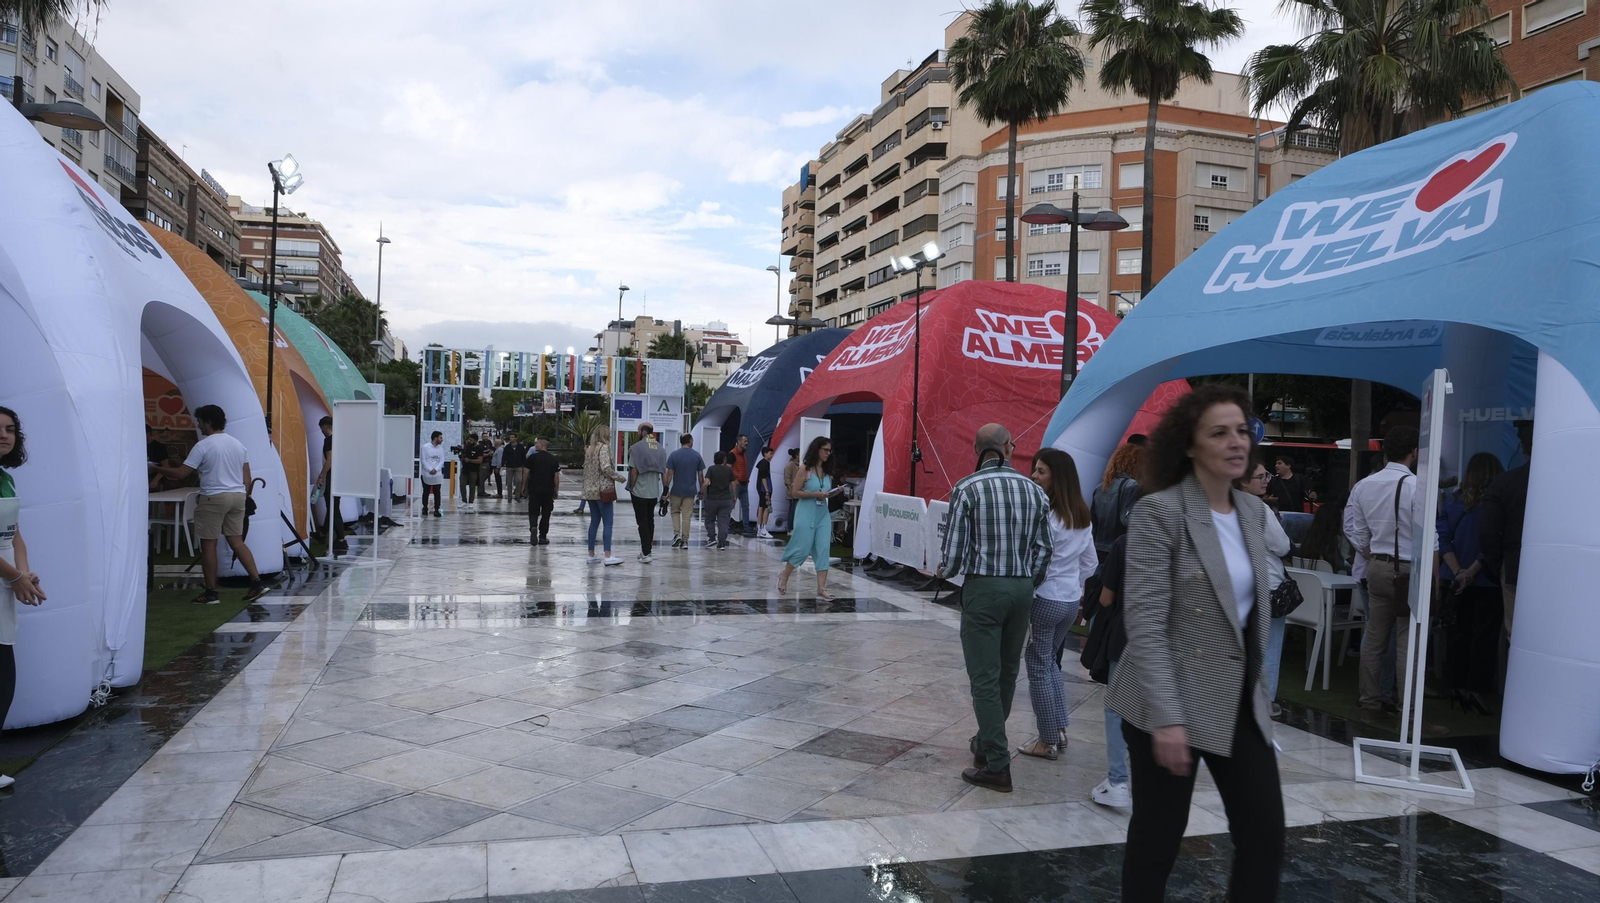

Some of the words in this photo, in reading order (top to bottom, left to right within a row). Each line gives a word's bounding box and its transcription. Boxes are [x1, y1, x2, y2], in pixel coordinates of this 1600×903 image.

[1281, 187, 1418, 241] WE
[1211, 189, 1494, 287] HUELVA
[865, 323, 903, 345] WE
[979, 311, 1053, 339] WE
[1459, 406, 1536, 422] HUELV
[875, 505, 883, 514] WE
[889, 508, 920, 521] BOQUERÓN
